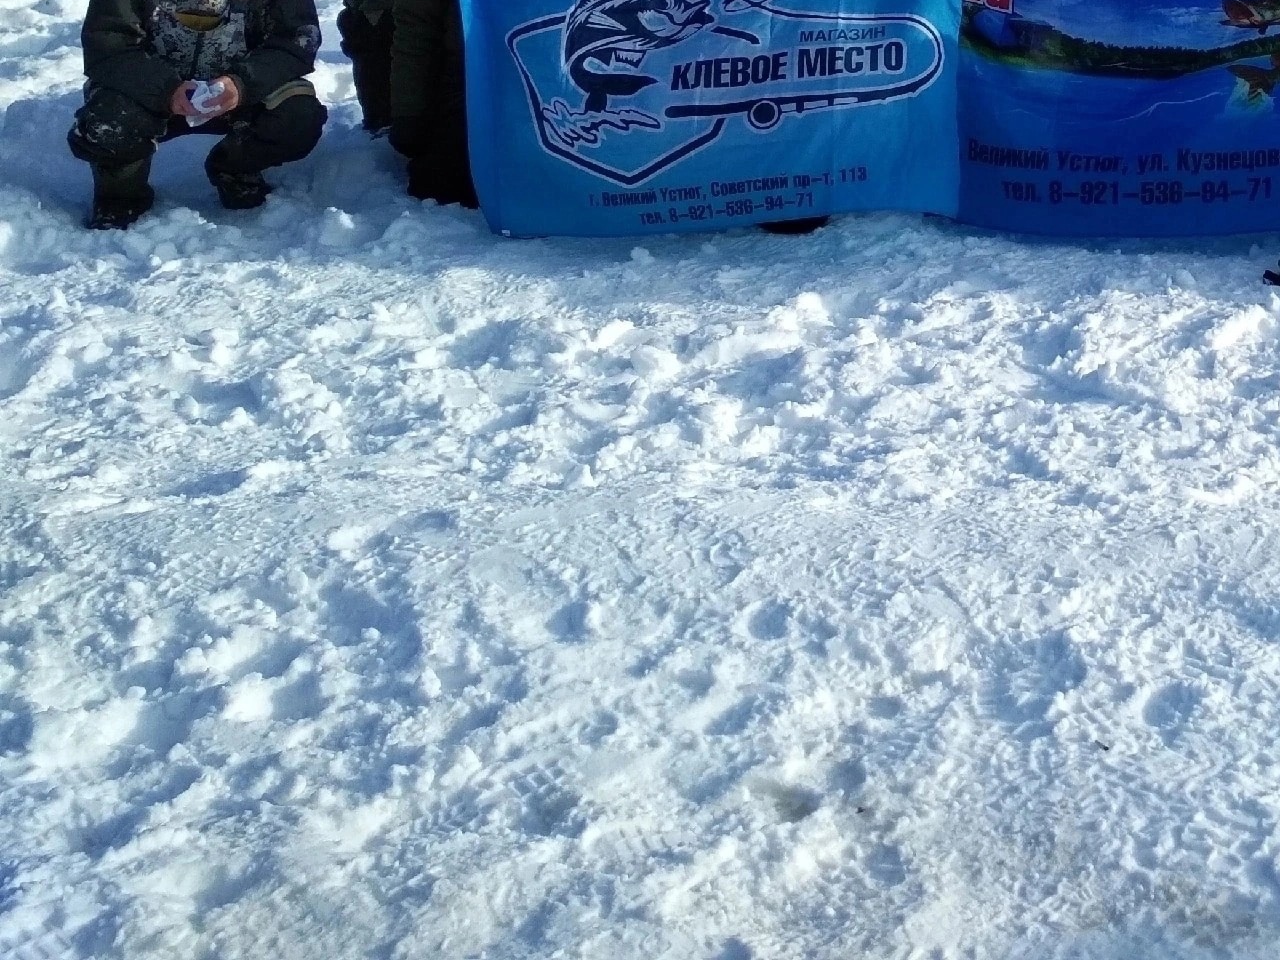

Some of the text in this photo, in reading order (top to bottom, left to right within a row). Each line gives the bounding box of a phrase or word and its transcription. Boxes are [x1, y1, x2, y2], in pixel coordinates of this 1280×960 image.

[799, 25, 886, 43] МАГАЗИН
[670, 41, 904, 91] КЛЕВОЕ МЕСТО
[967, 138, 1049, 171] Великий
[1055, 149, 1129, 176] Устюг,
[1137, 151, 1169, 175] ул.
[602, 188, 657, 208] Великий
[659, 185, 708, 204] Устюг,
[710, 172, 789, 197] Советский
[839, 166, 868, 184] 113
[1001, 180, 1039, 203] тел.
[639, 210, 667, 226] тел.
